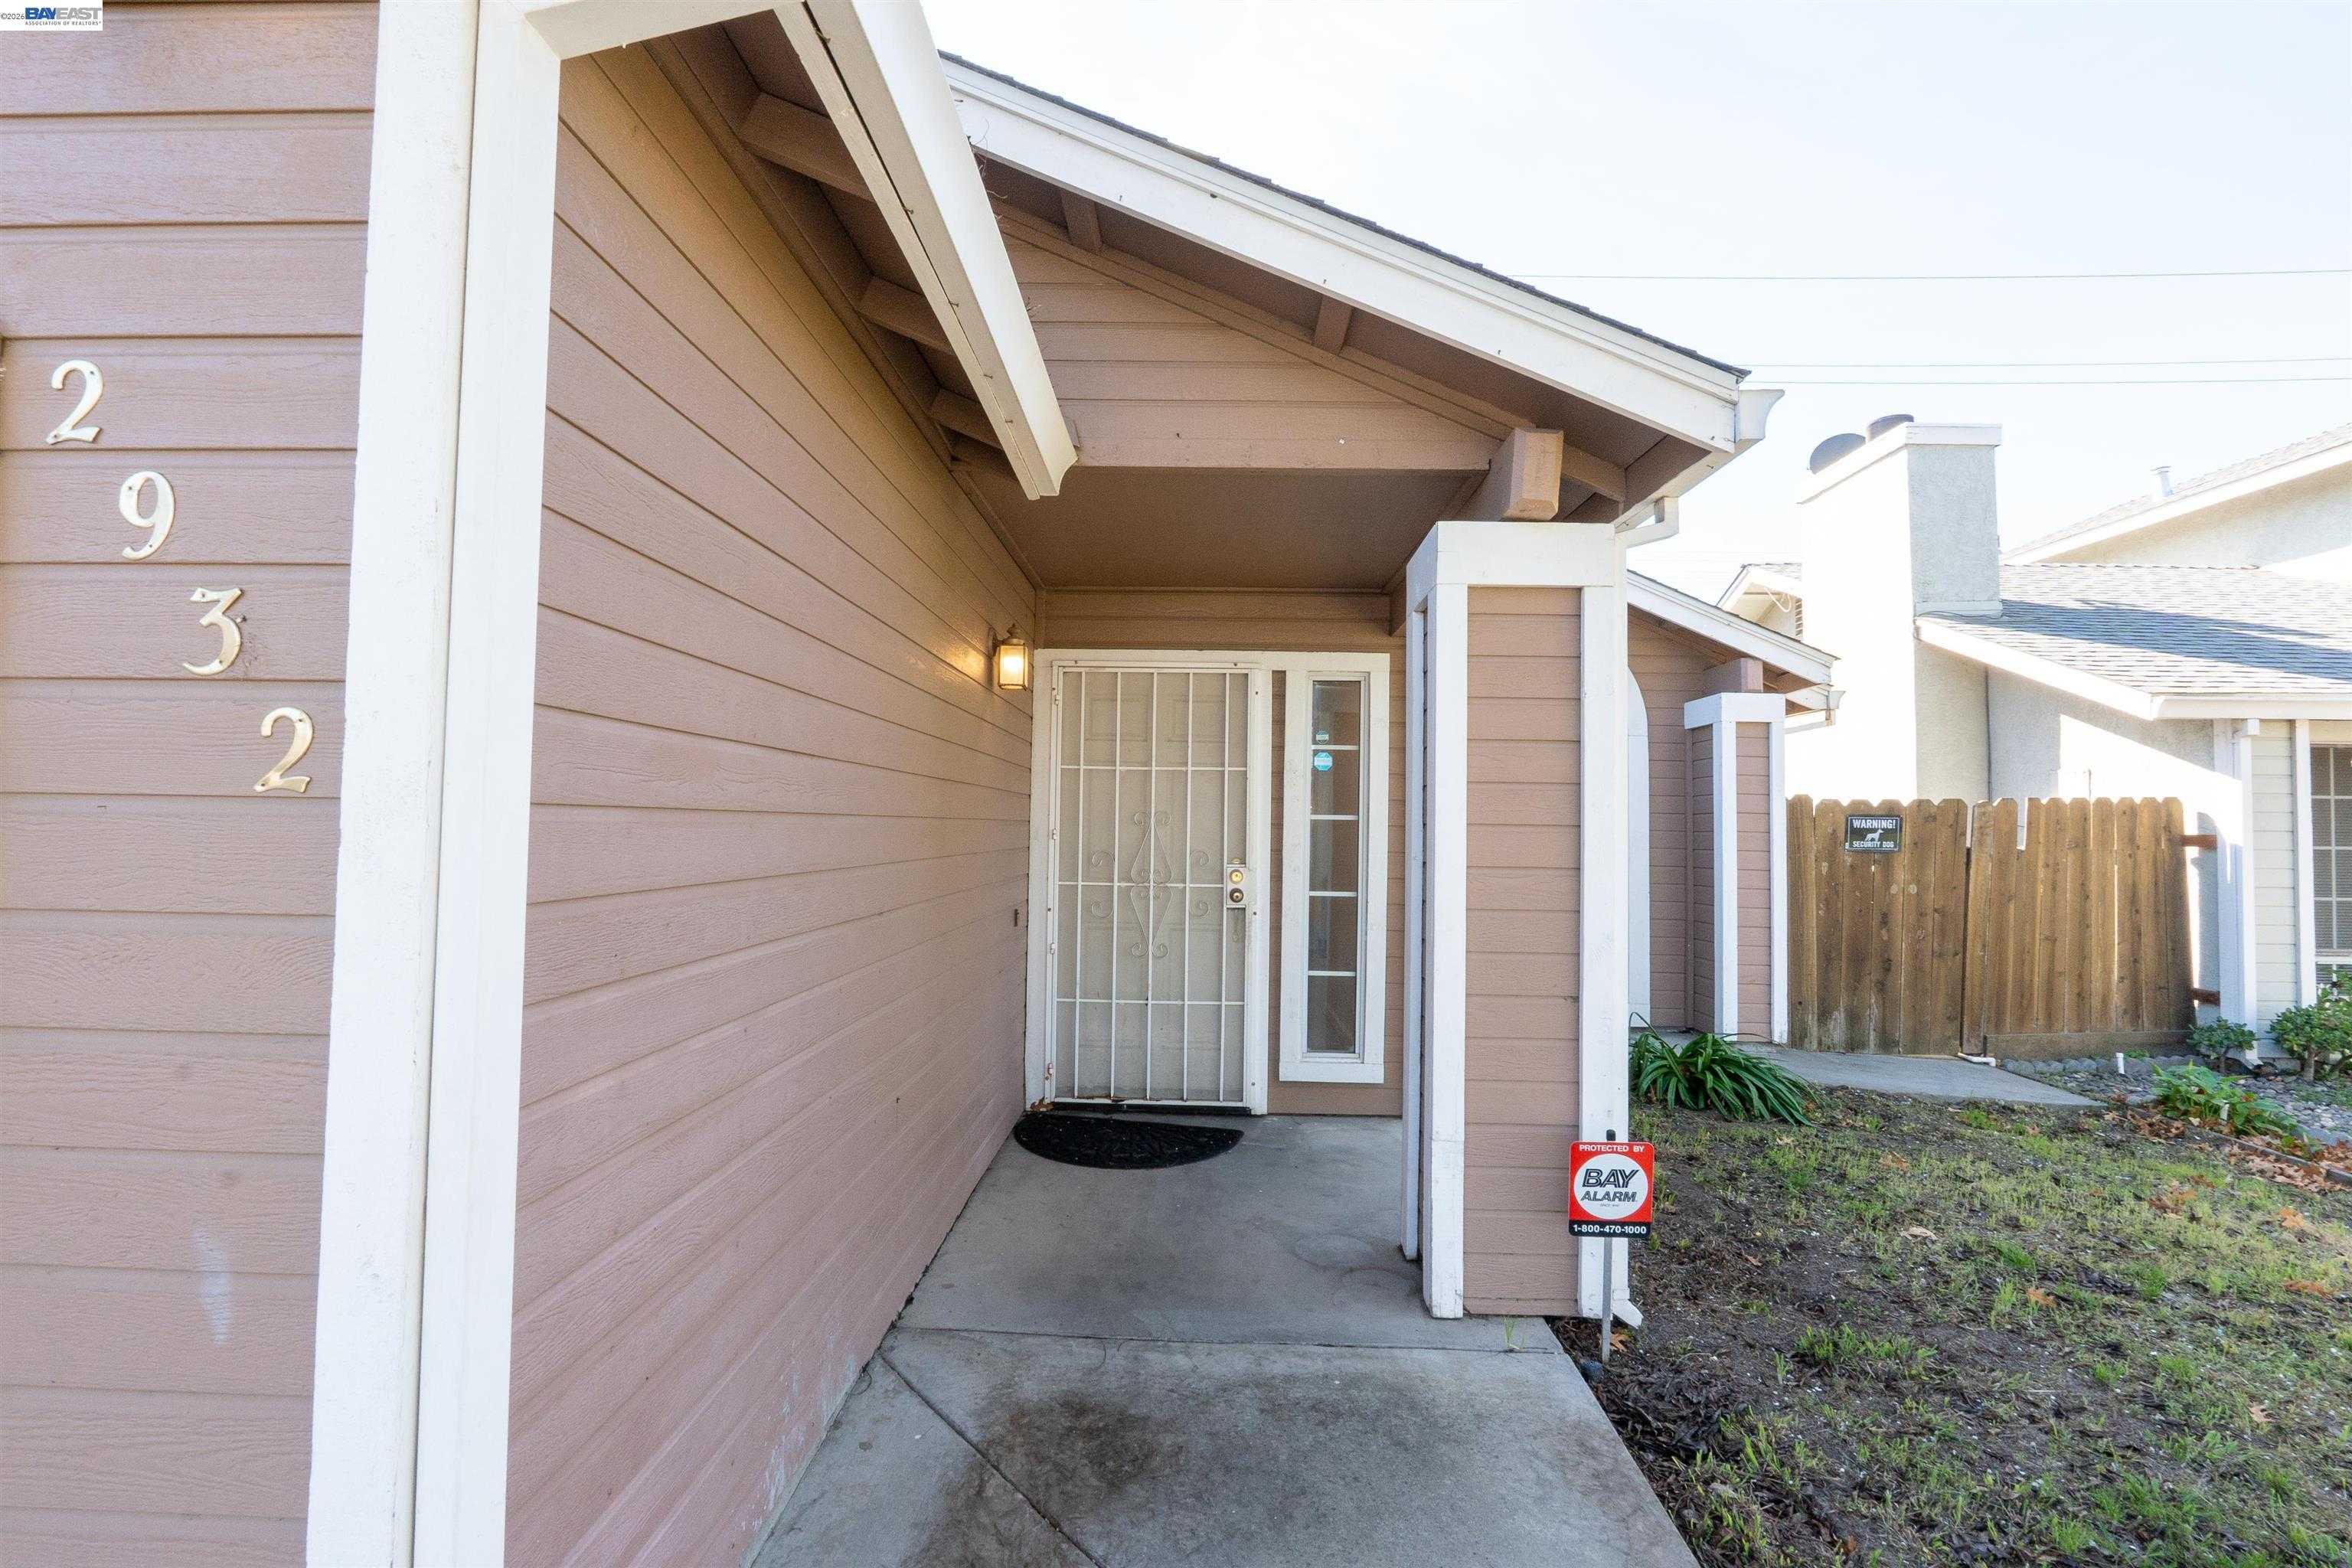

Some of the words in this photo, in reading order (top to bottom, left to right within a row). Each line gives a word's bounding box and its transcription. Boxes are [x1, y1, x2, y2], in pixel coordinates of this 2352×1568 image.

[1853, 819, 1896, 828] WARNING!
[1579, 1144, 1629, 1152] PROTECTED
[1582, 1168, 1640, 1188] BAY
[1580, 1191, 1637, 1202] ALARM
[1573, 1224, 1647, 1233] 1-800-470-1000
